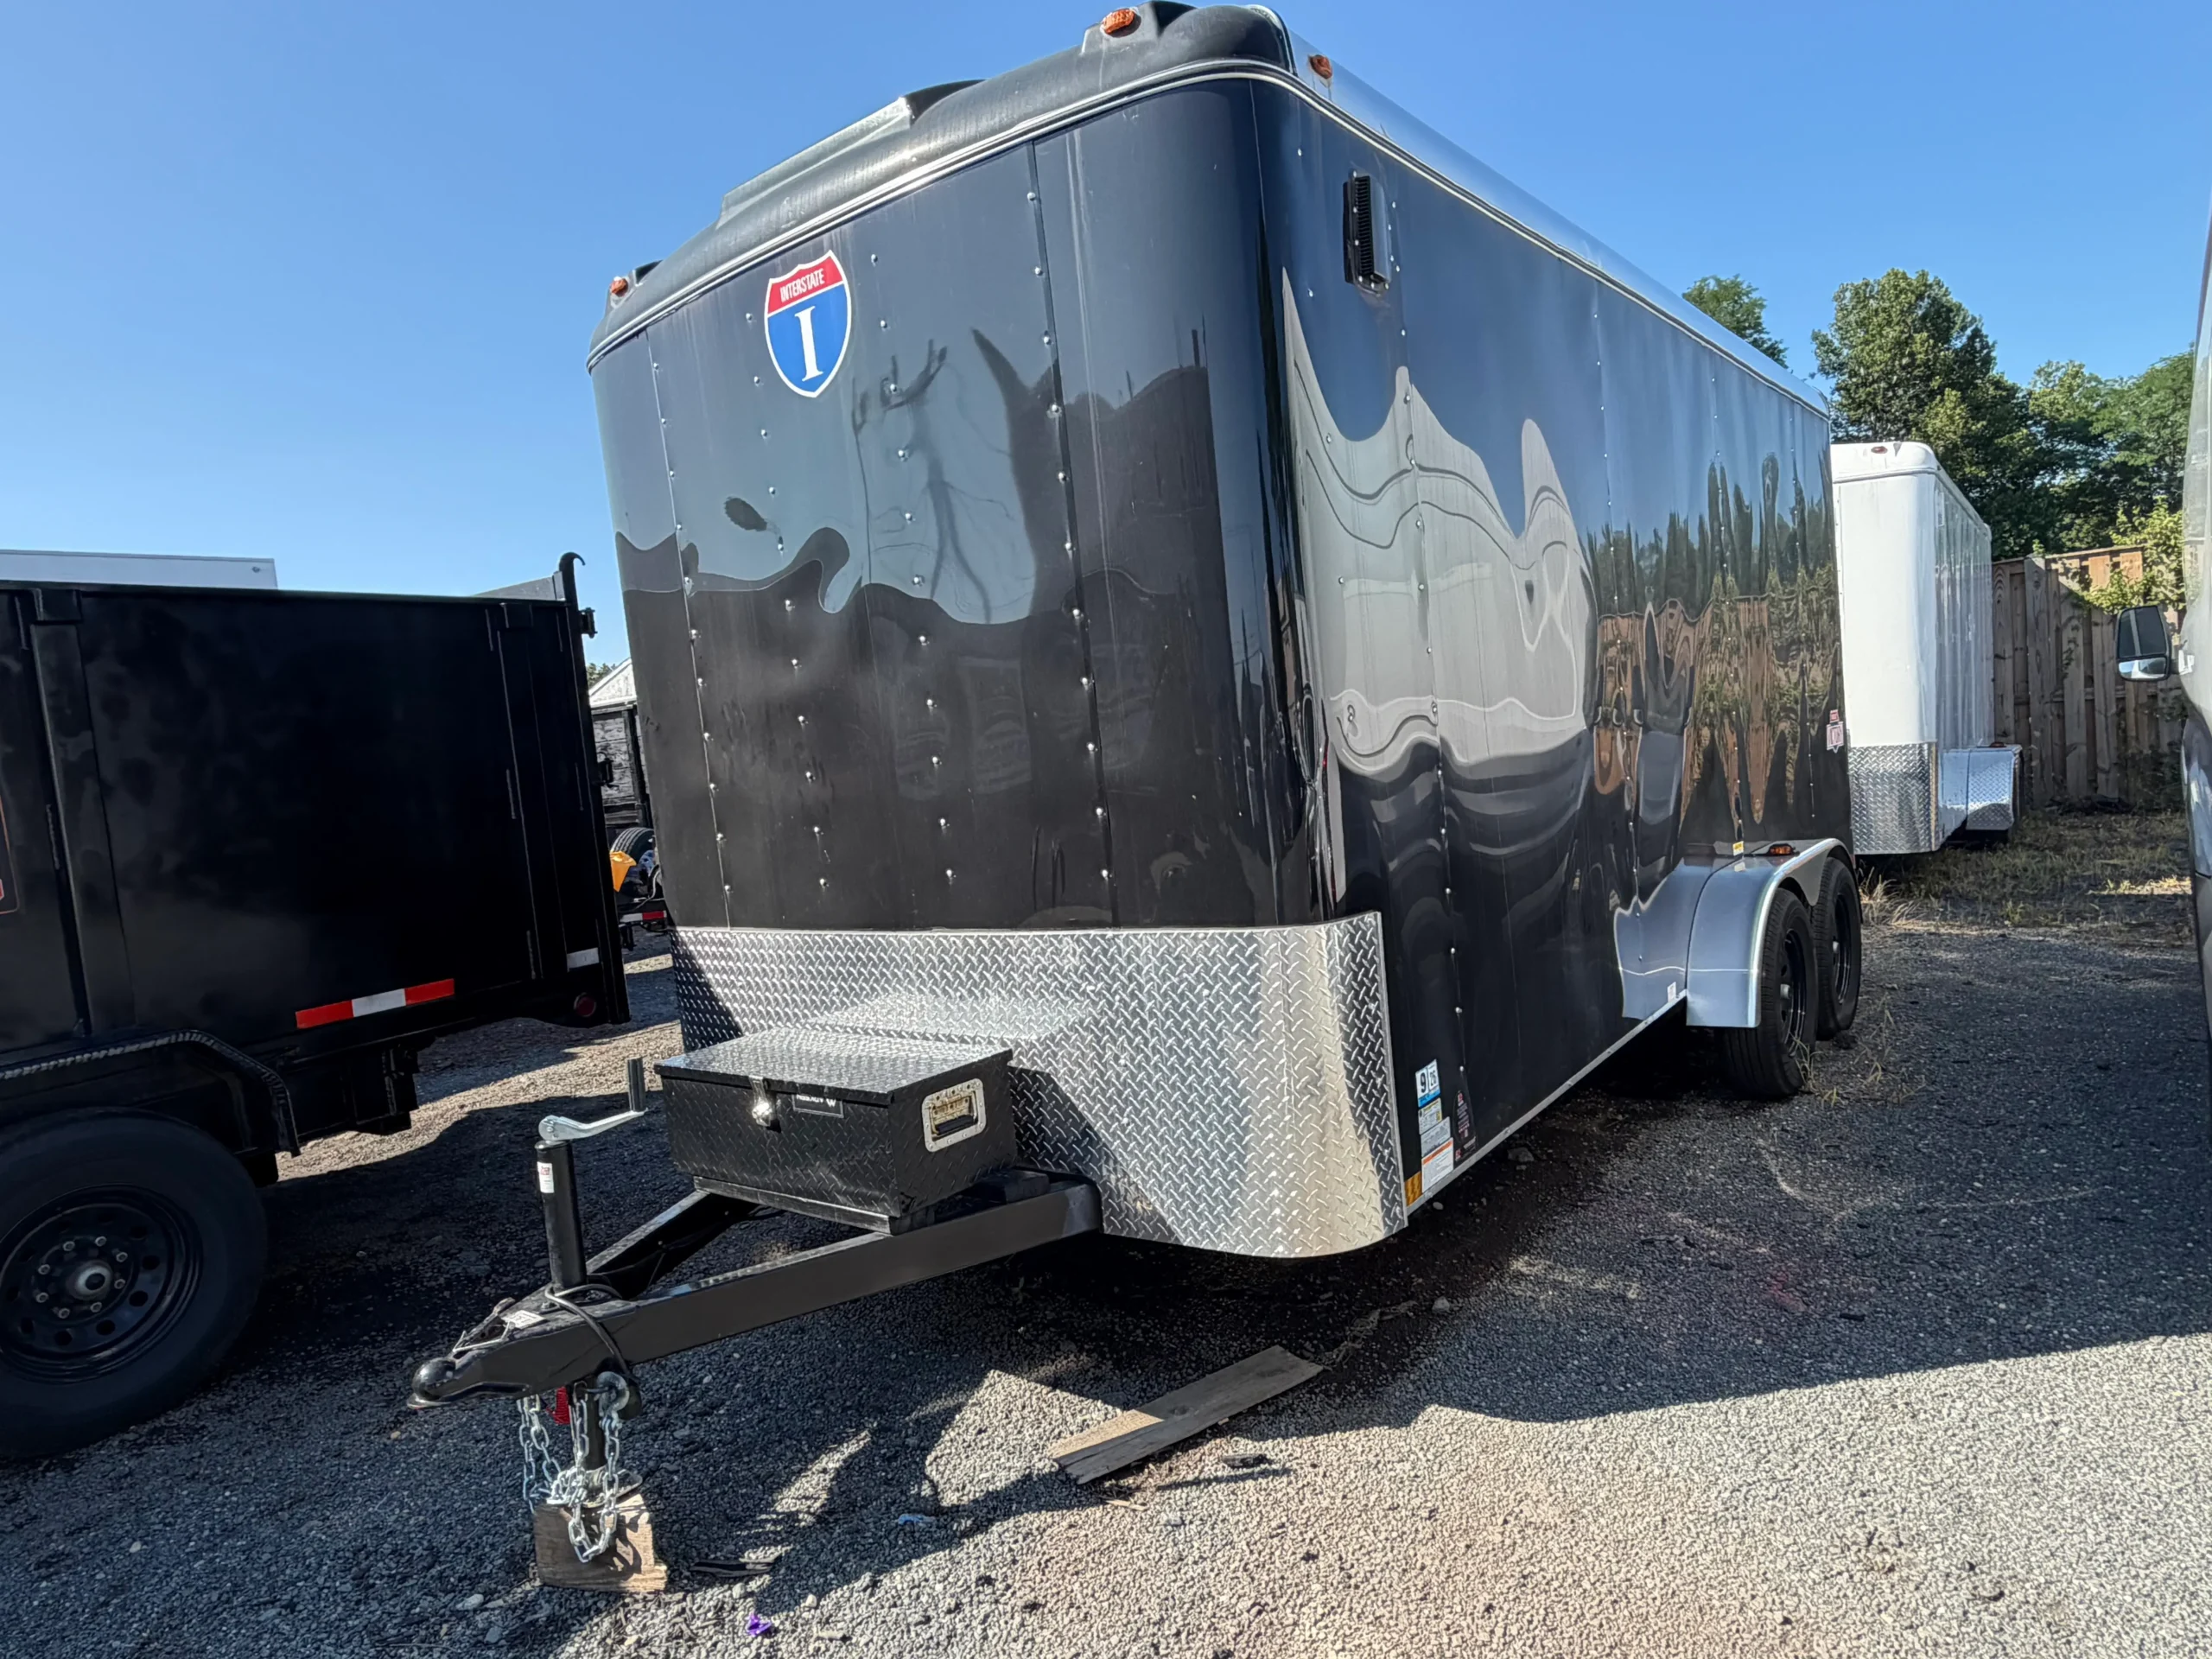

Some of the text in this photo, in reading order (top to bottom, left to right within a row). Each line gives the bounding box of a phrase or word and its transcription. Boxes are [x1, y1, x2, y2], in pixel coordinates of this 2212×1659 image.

[780, 269, 825, 302] INTERSTATE
[794, 306, 823, 381] I
[1420, 1072, 1427, 1093] 9
